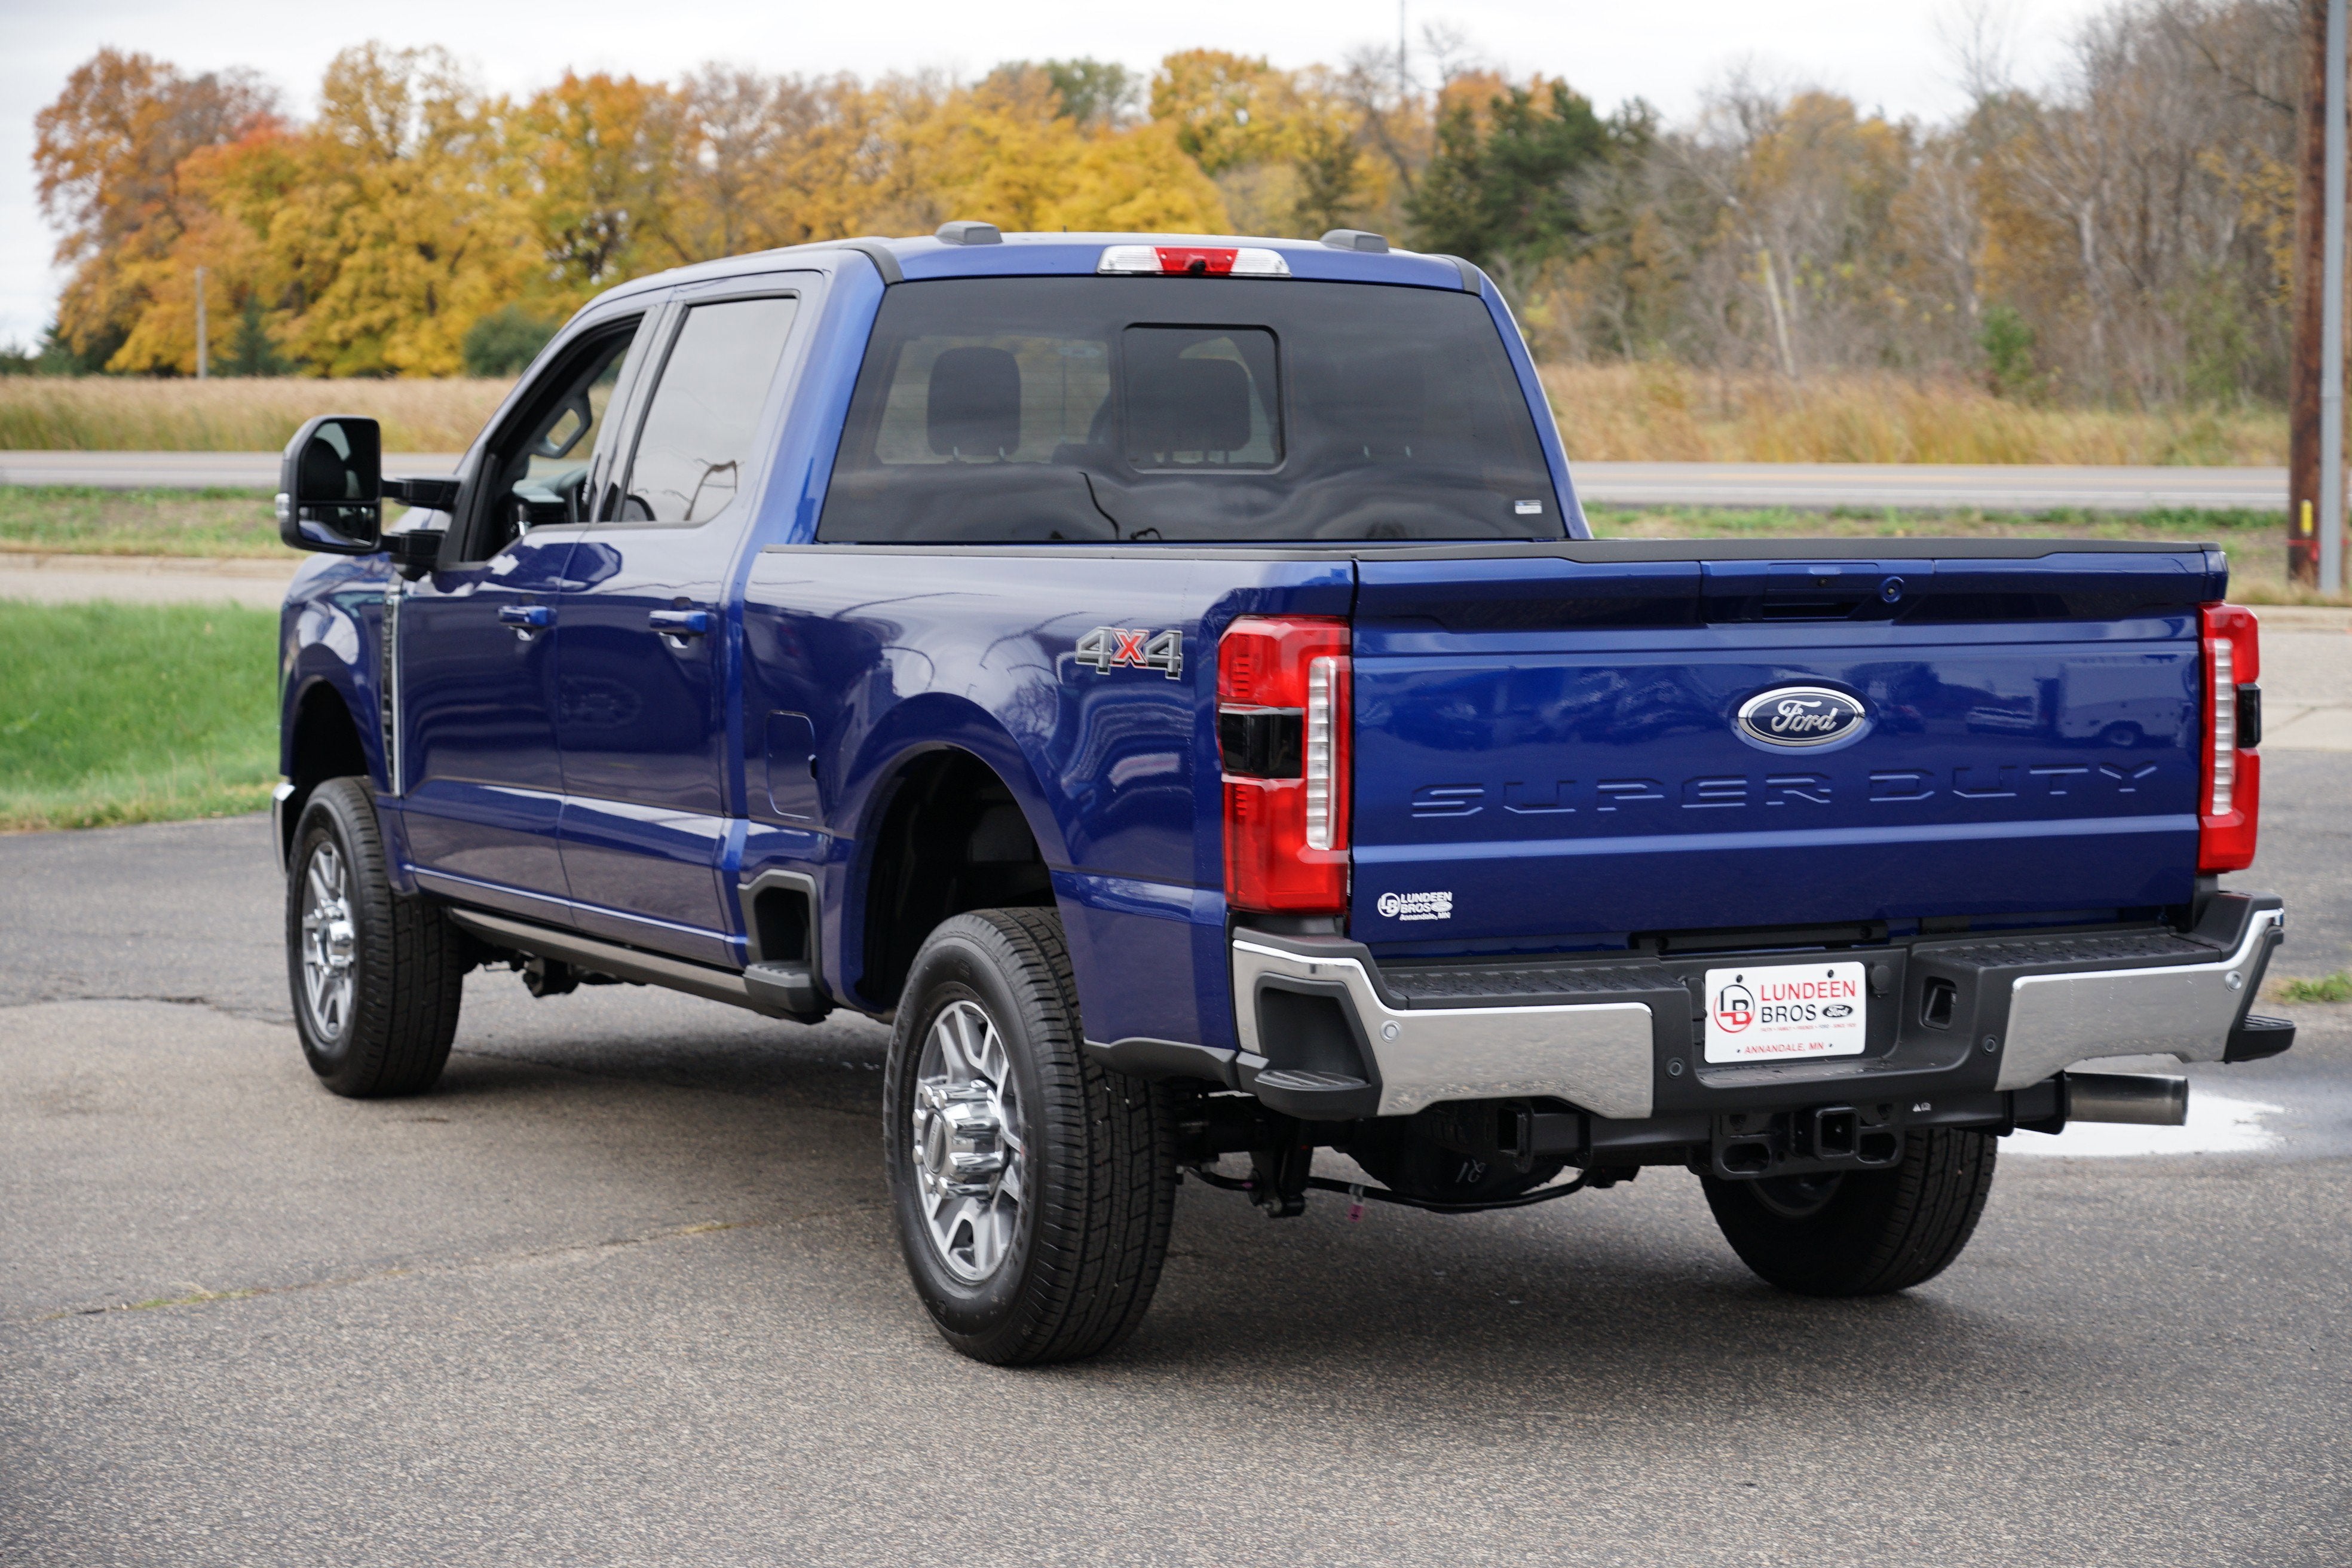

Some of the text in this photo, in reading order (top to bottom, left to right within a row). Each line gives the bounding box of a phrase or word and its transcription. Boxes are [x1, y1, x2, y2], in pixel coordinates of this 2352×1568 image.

[1771, 700, 1839, 732] Ford
[1412, 761, 2158, 817] SUPER DUTY
[1401, 892, 1453, 904] LUNDEEN
[1400, 903, 1432, 914] BROS
[1760, 980, 1856, 1002] LUNDEEN
[1762, 1004, 1816, 1023] BROS
[1809, 1042, 1824, 1051] MN
